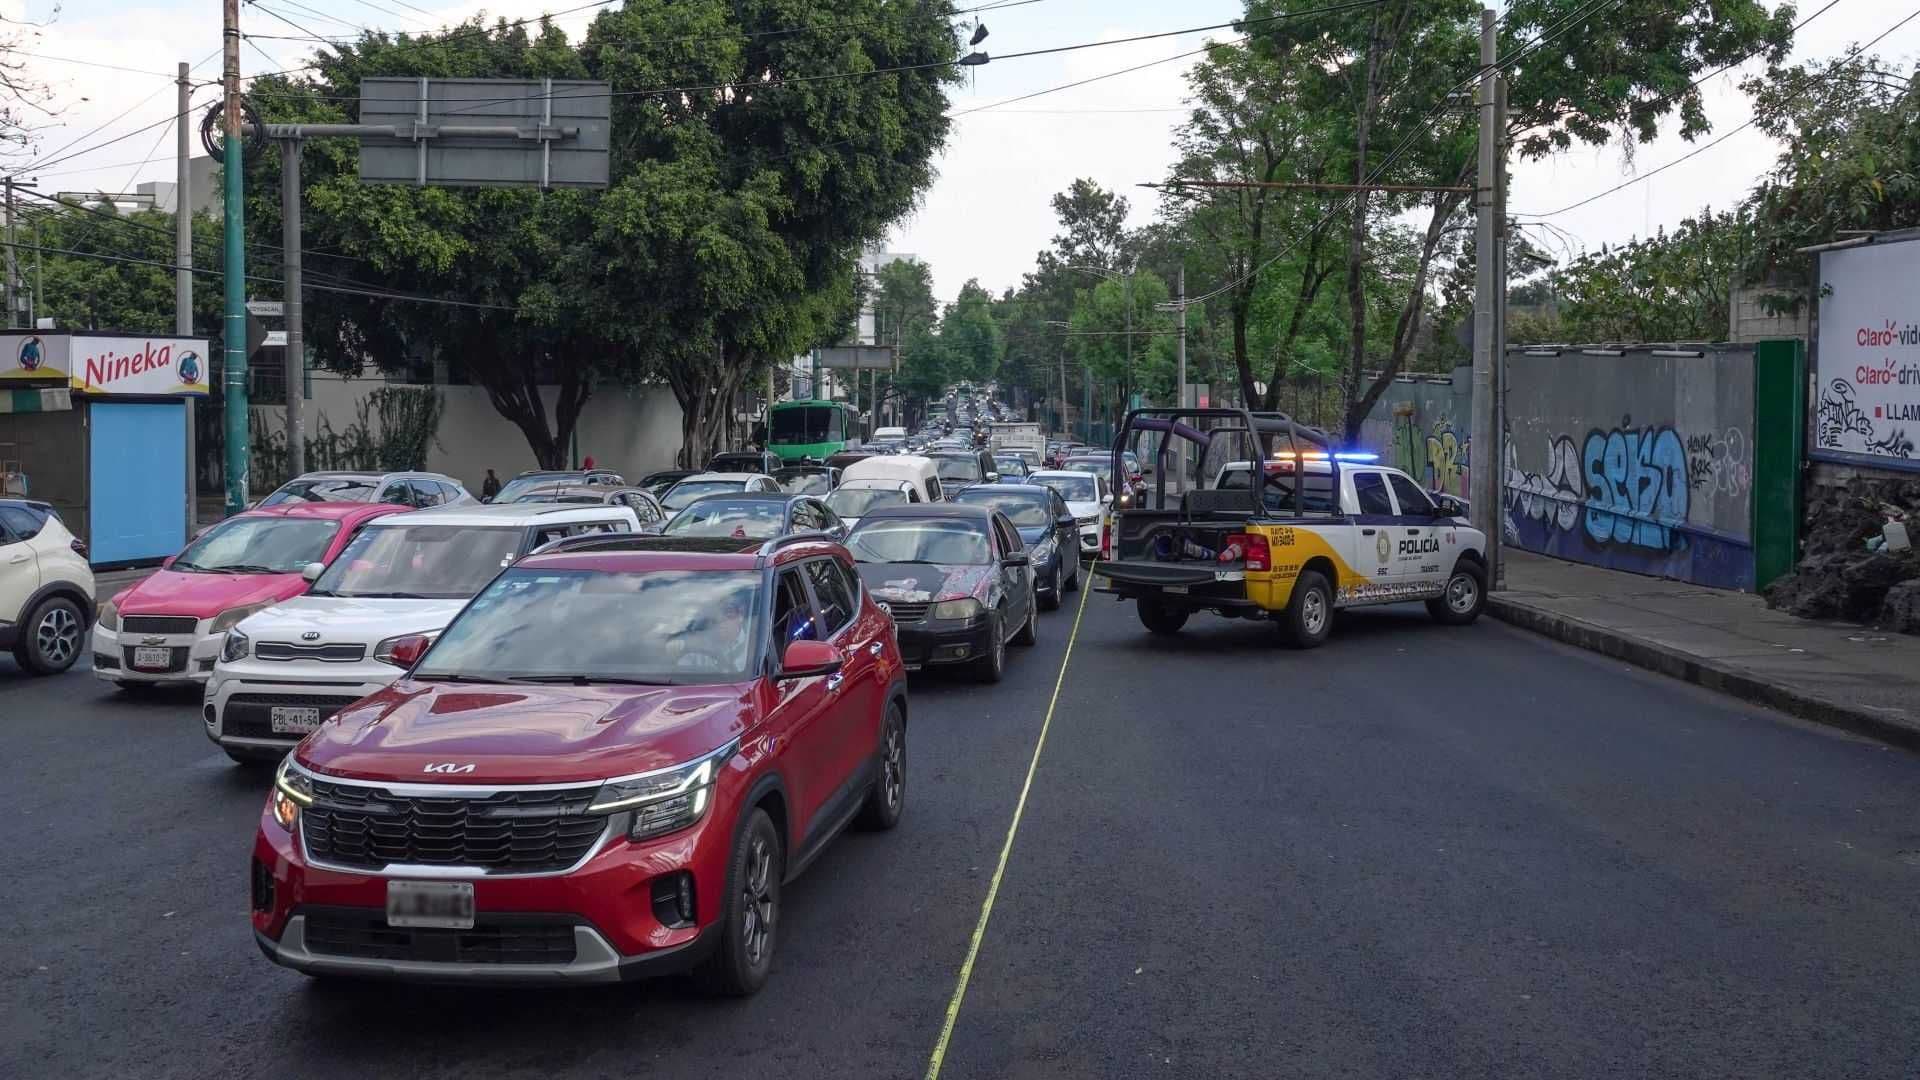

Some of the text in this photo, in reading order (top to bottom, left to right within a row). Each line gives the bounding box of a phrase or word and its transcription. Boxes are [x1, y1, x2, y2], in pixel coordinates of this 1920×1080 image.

[85, 341, 171, 389] Nineka
[1399, 534, 1440, 554] POLICÍA
[424, 763, 476, 773] KIA
